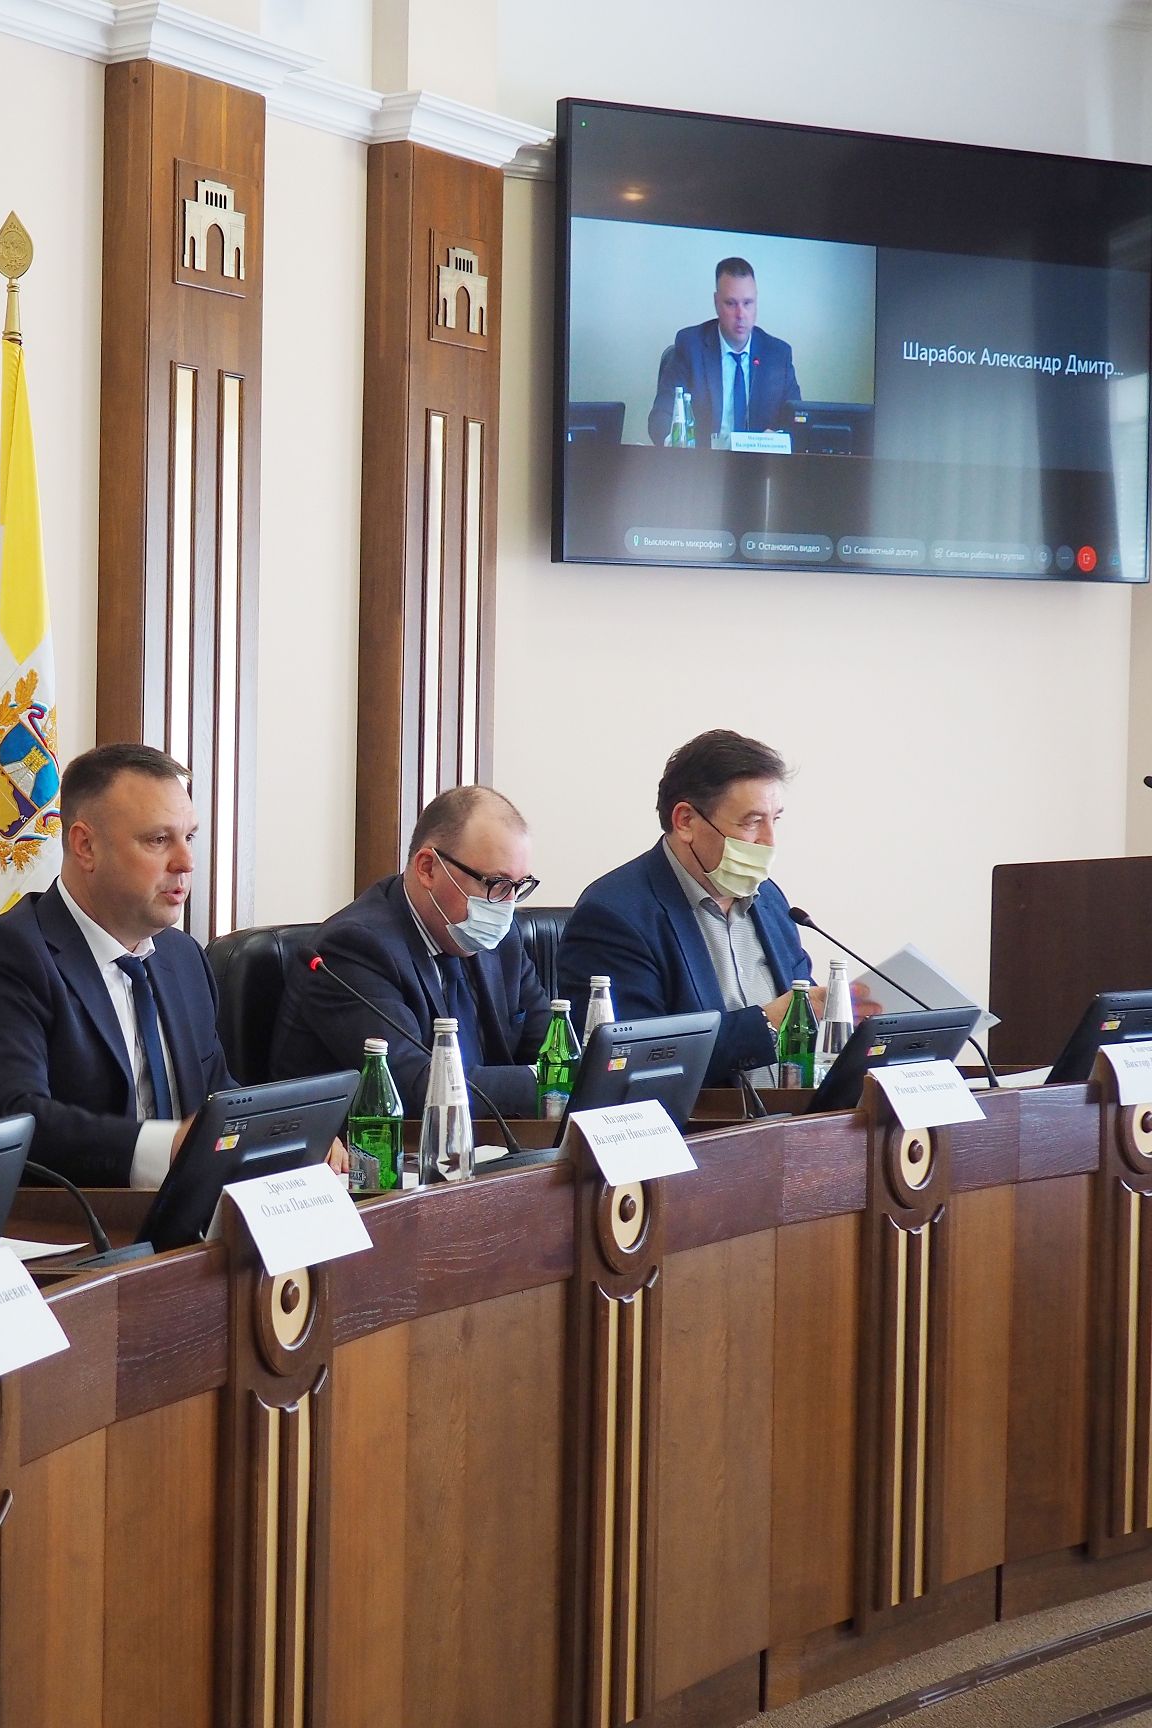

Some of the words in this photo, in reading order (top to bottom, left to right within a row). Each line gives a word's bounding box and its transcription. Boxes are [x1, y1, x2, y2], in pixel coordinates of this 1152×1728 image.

[903, 341, 976, 367] Шарабок
[980, 348, 1062, 376] Александр
[1064, 354, 1124, 379] Дмитр...
[644, 537, 685, 548] Выключить
[686, 540, 723, 550] микрофон
[758, 543, 799, 552] Остановить
[800, 545, 820, 554] видео
[895, 549, 919, 559] доступ
[601, 1111, 644, 1125] Назаренко
[592, 1129, 628, 1146] Валерий
[626, 1124, 673, 1141] Николаевич
[264, 1177, 307, 1196] Дроздова
[260, 1200, 291, 1218] Ольга
[289, 1192, 335, 1211] Павловна
